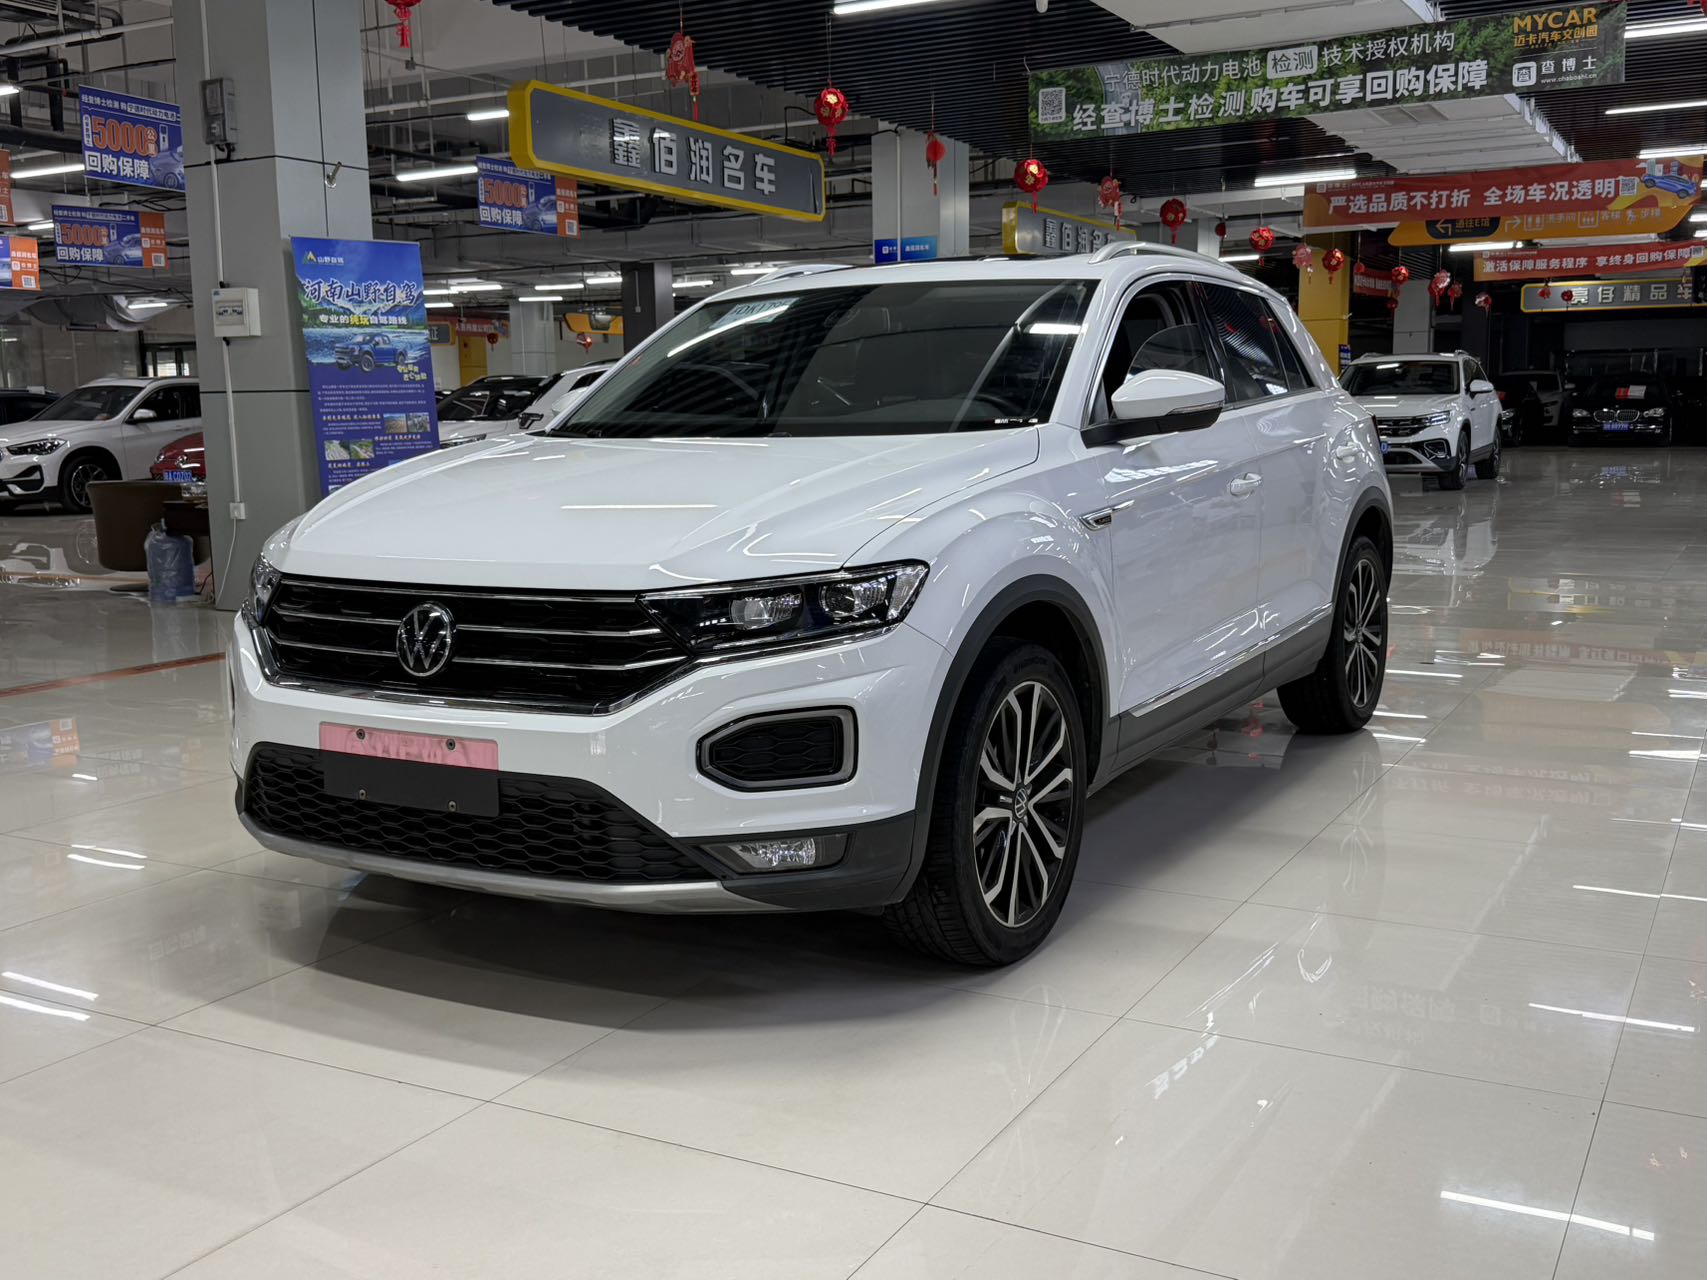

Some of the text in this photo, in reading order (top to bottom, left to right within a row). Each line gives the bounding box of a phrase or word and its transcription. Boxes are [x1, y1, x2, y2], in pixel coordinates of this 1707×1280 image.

[1513, 7, 1597, 33] MYCAR
[1513, 24, 1599, 48] 迈卡汽车文创园
[1103, 30, 1455, 92] 宁德时代动力电池 检测 技术授权机构
[1540, 55, 1598, 75] 查博士
[1540, 73, 1598, 84] www.chaboshi.cn
[1072, 58, 1489, 132] 经查博士检测购车可享回购保障
[91, 115, 148, 156] 5000
[84, 150, 150, 180] 回购保障
[610, 117, 776, 196] 鑫佰润名车
[484, 178, 524, 208] 5000
[1327, 178, 1615, 215] 严选品质不打折 全场车况透明
[480, 205, 523, 227] 回购保障
[61, 223, 102, 247] 5000
[57, 246, 104, 262] 回购保障
[1482, 247, 1691, 273] 激活保障服务程序 享终身回购保障
[303, 278, 417, 306] 河南山野自驾
